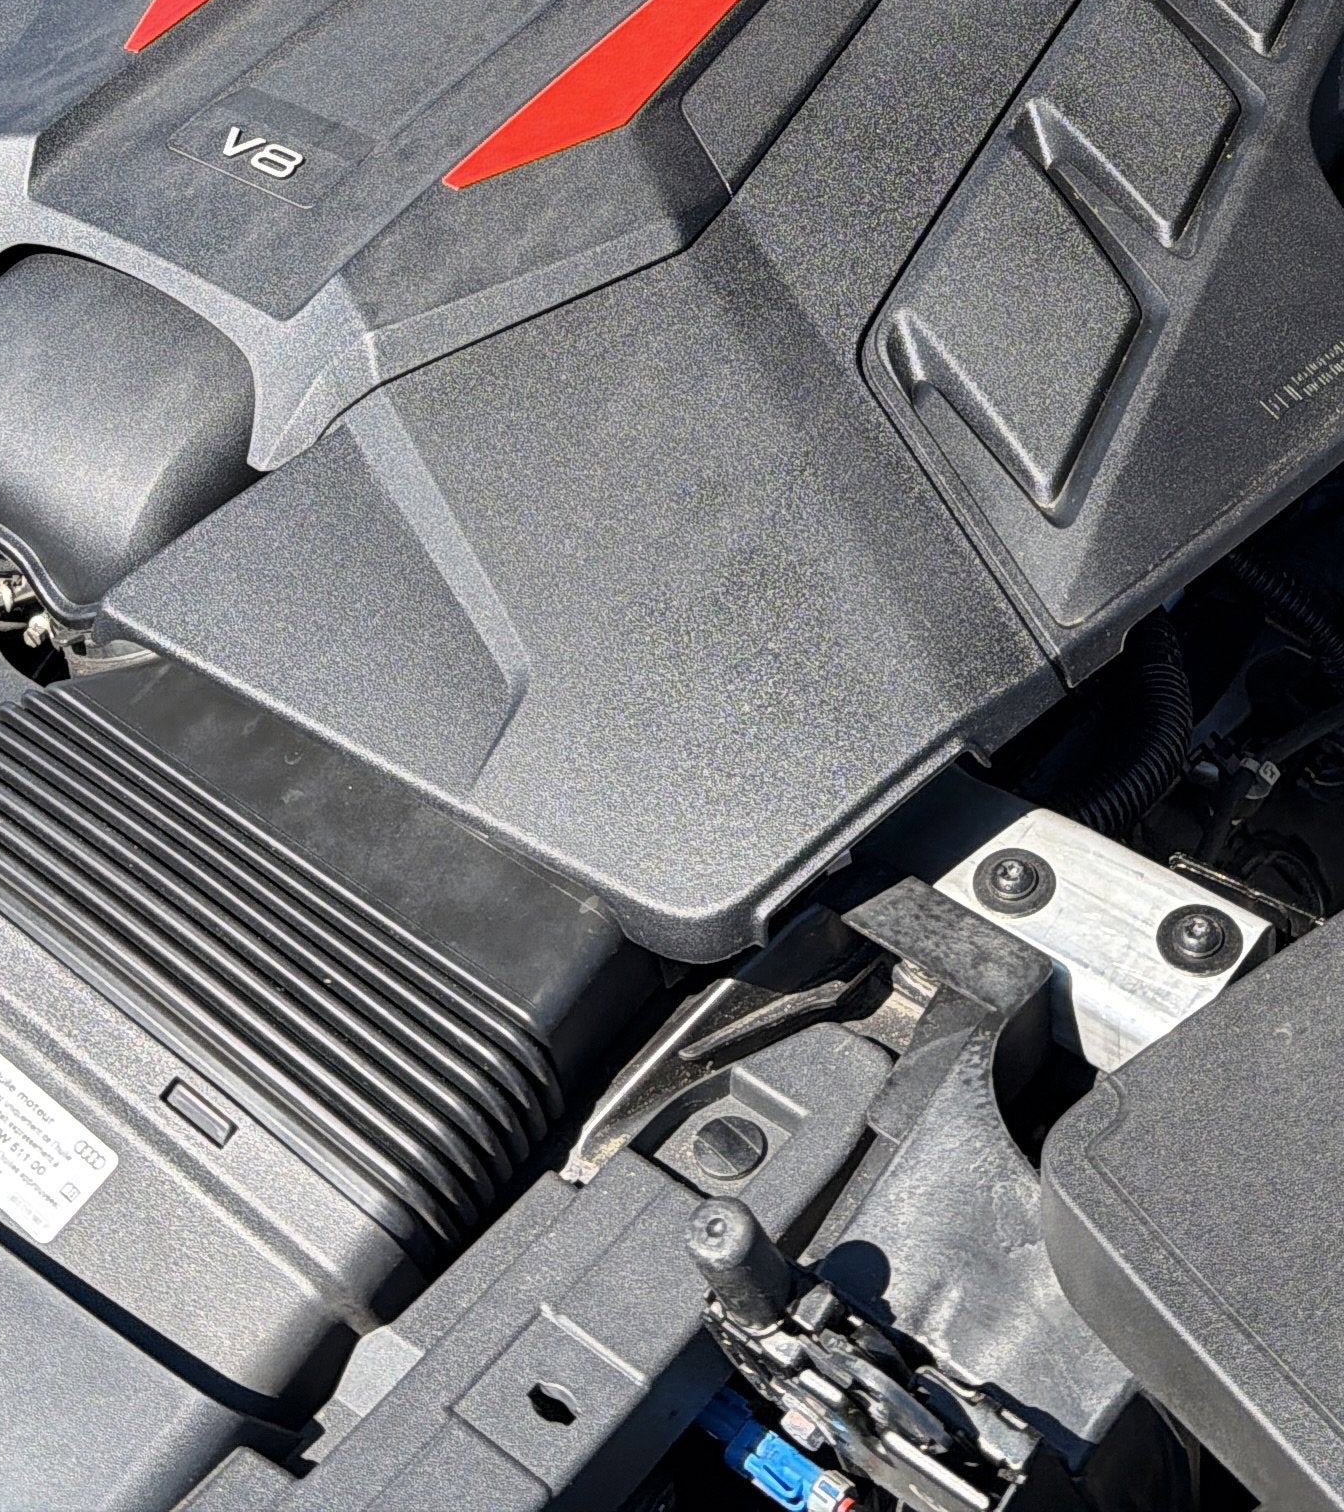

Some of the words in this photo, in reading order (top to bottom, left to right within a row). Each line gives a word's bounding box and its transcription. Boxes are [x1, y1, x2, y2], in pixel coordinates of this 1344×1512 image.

[222, 126, 304, 178] V8
[16, 1090, 56, 1126] moteur
[29, 1159, 47, 1177] 00
